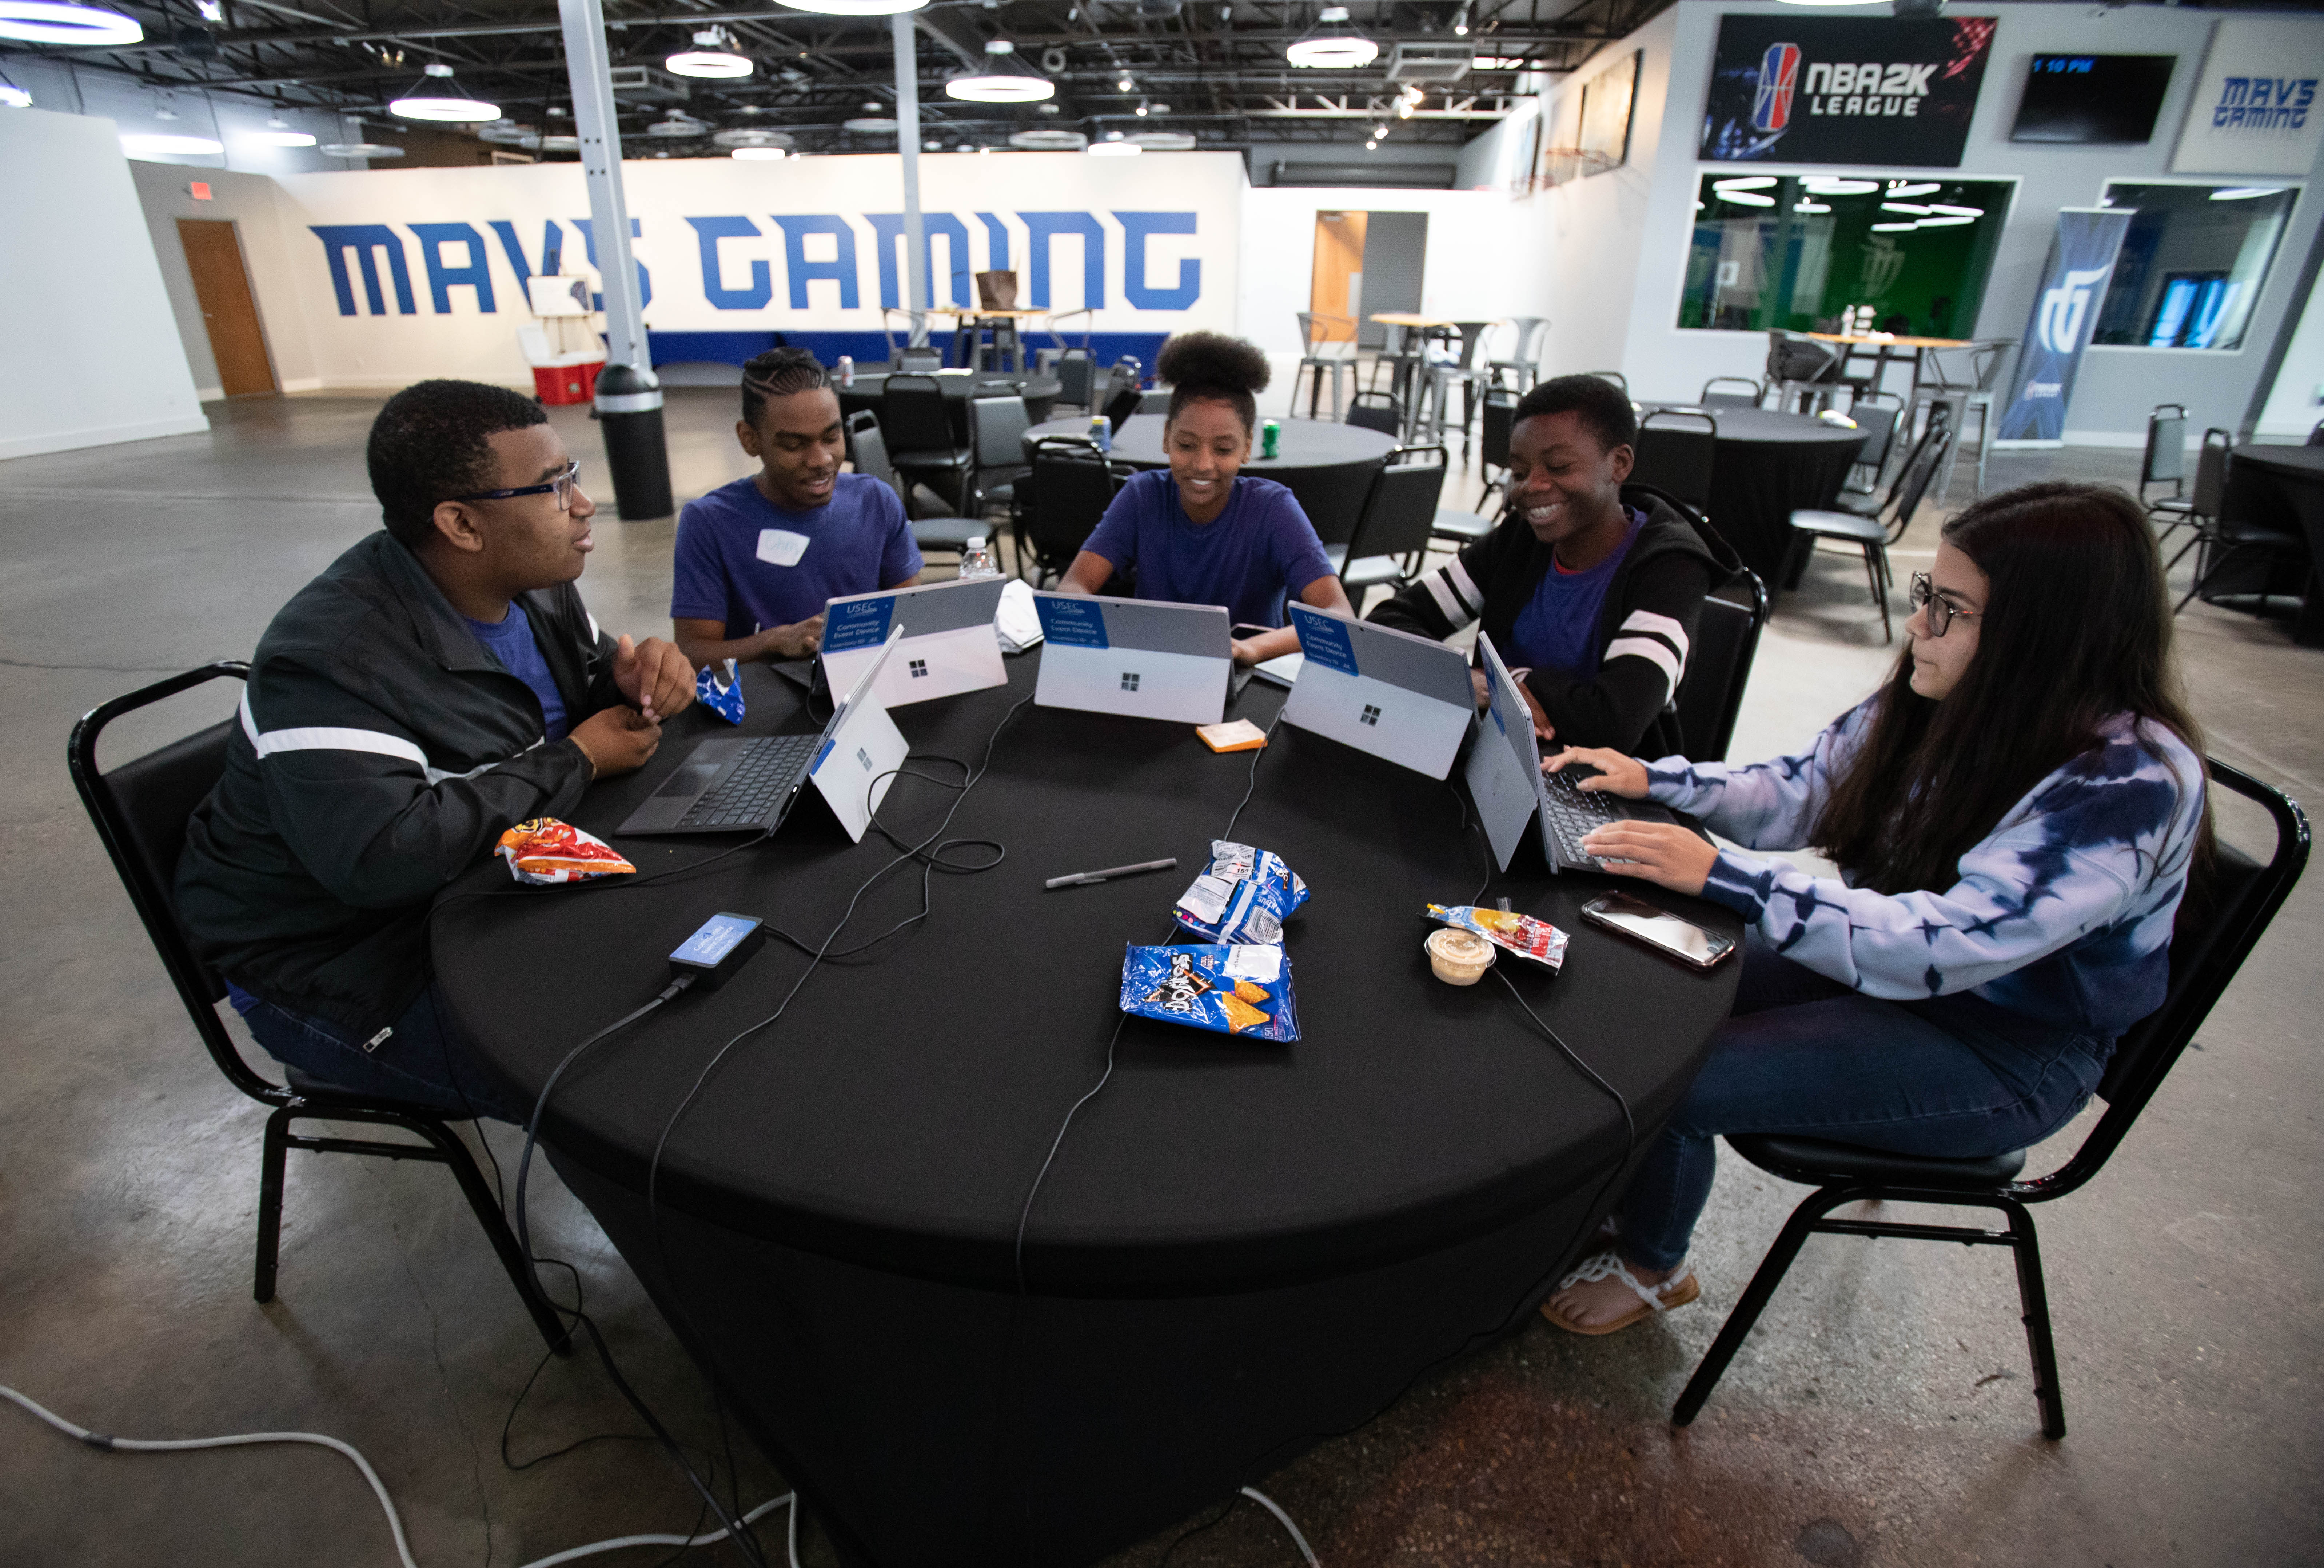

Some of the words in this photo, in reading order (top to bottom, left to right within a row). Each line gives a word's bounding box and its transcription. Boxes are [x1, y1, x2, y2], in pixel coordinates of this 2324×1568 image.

[2067, 59, 2094, 73] PM
[1804, 63, 1939, 96] NBA2K
[2219, 77, 2318, 106] MAVS
[1810, 95, 1921, 117] LEAGUE
[2212, 106, 2308, 129] GAMING
[684, 211, 1201, 311] GAMING
